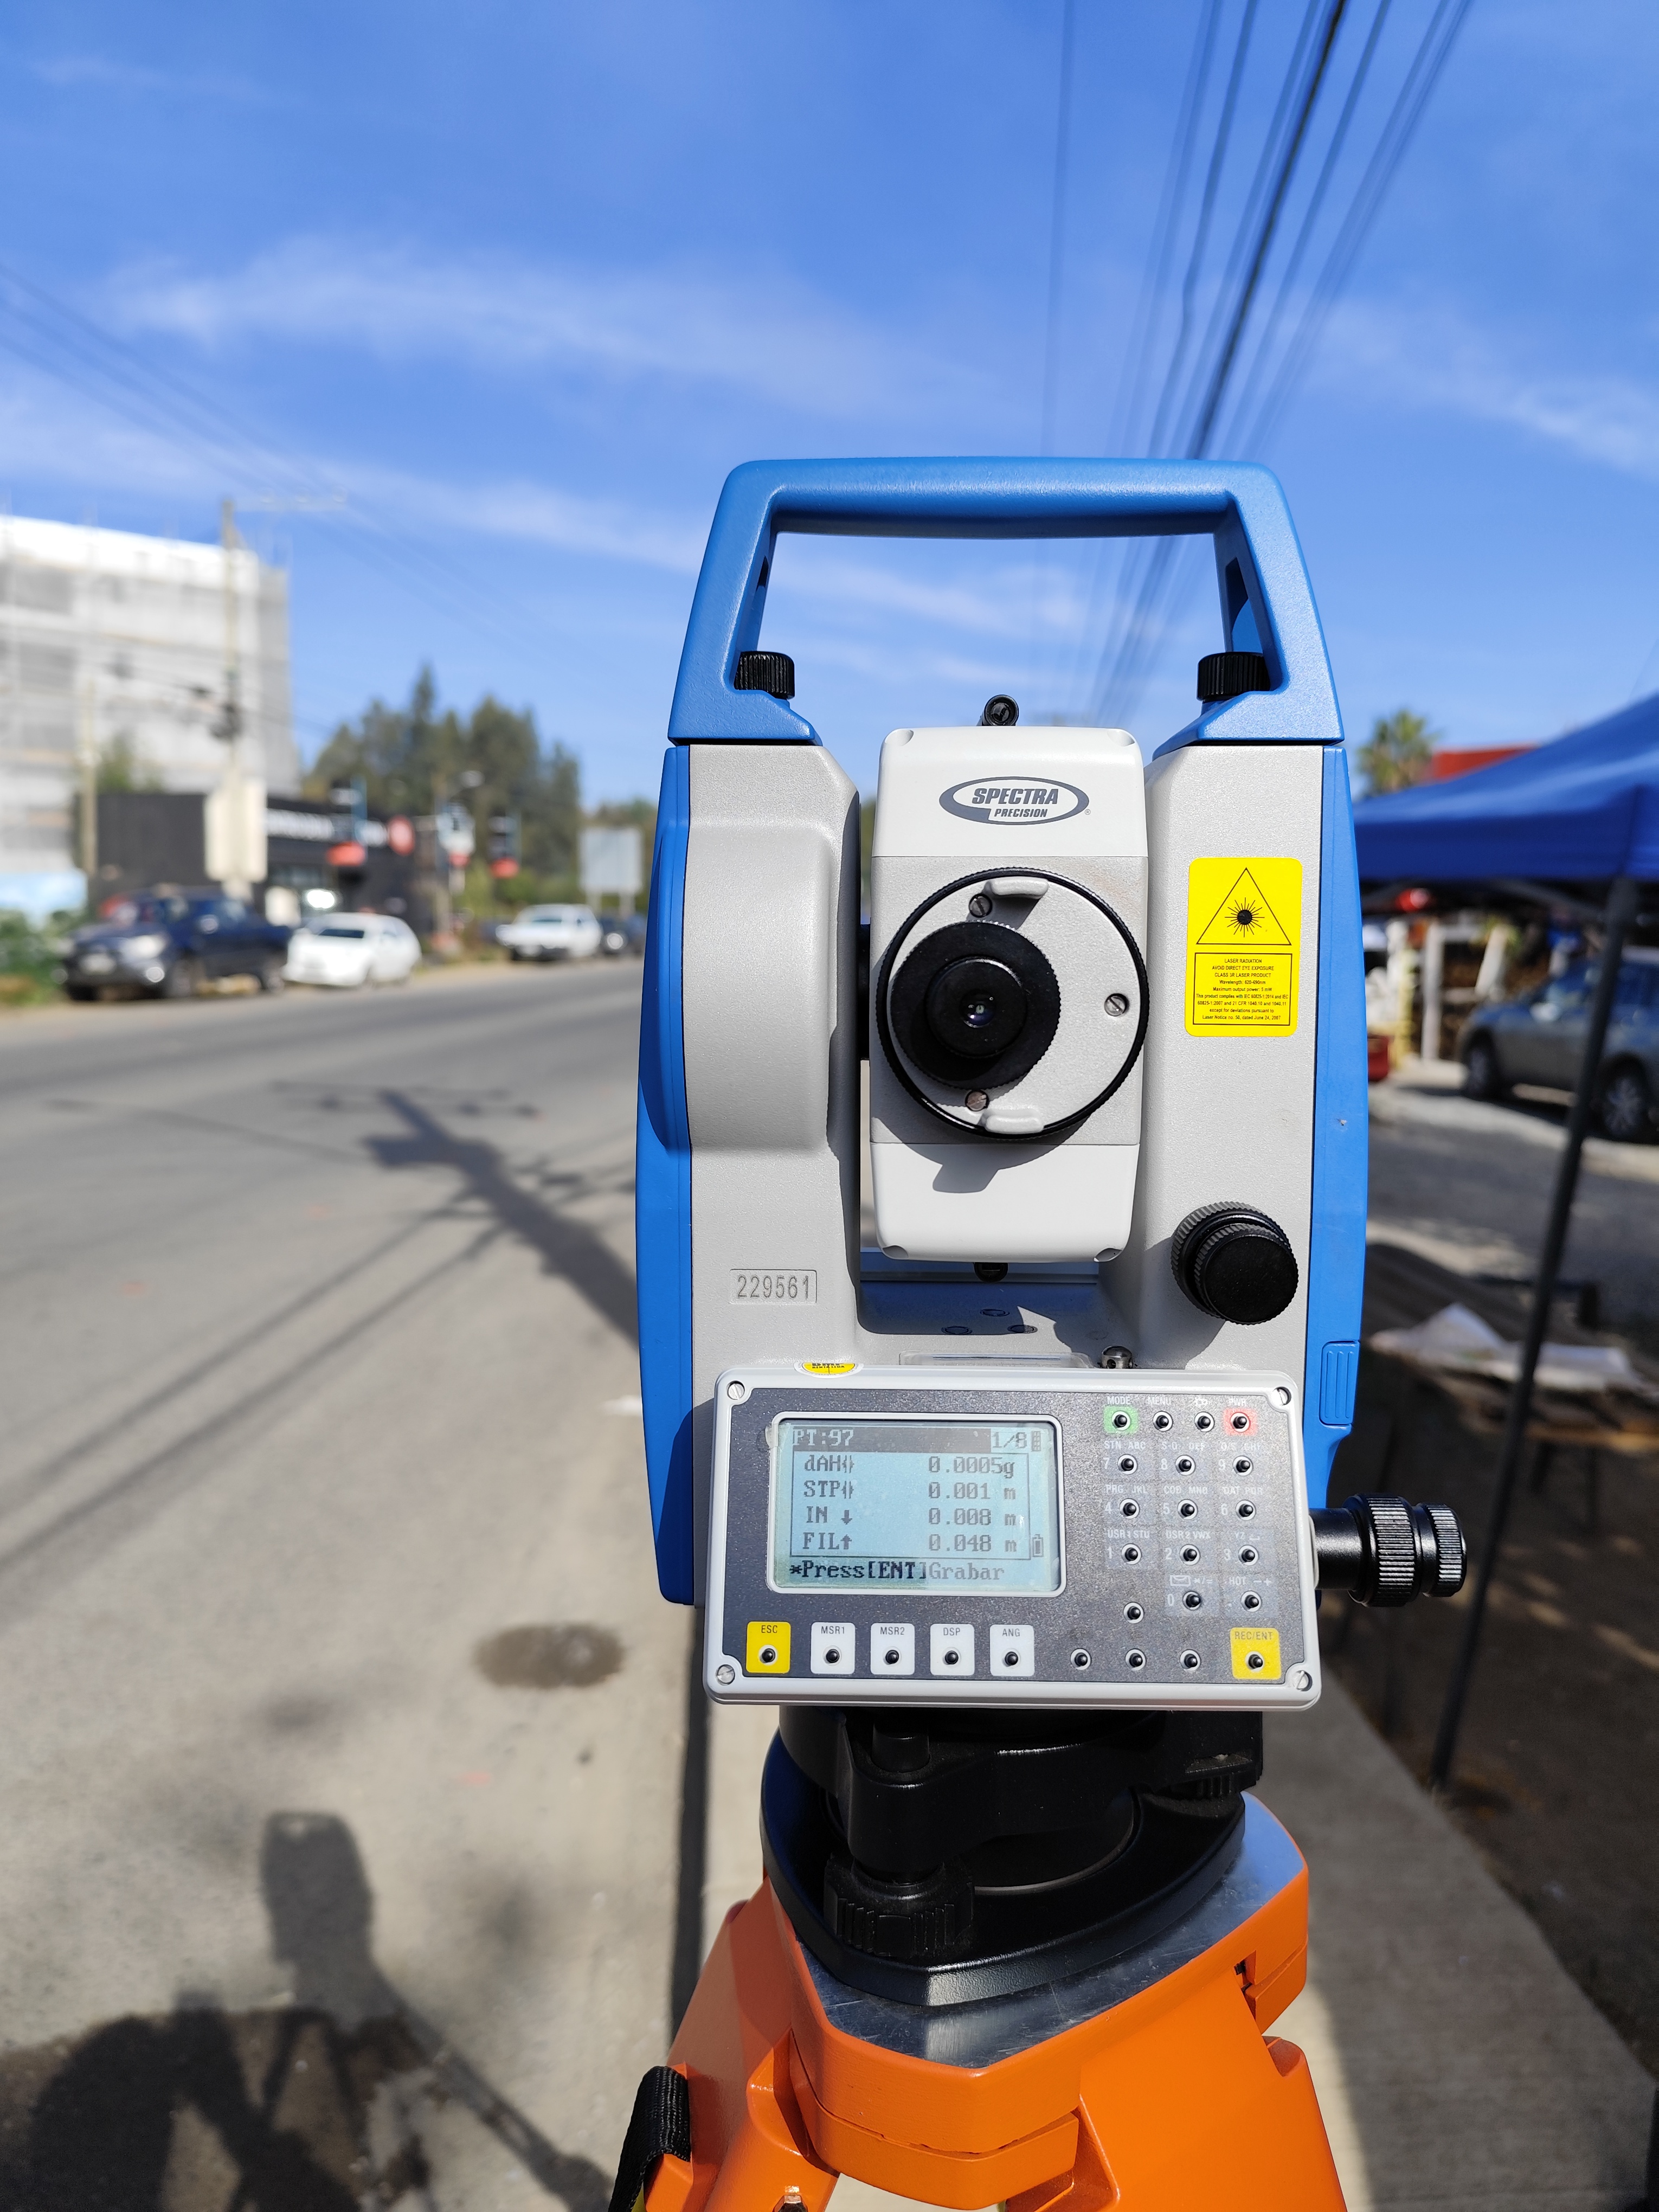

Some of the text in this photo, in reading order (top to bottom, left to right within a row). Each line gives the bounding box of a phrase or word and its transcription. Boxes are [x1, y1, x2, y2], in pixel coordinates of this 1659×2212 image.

[972, 788, 1059, 805] SPECTRA
[994, 808, 1048, 818] PRECISION
[737, 1275, 809, 1299] 229561
[1107, 1396, 1130, 1405] MODE
[1147, 1397, 1171, 1405] MENU
[1229, 1398, 1247, 1406] PWR
[793, 1429, 1027, 1449] PT:97 1/8
[1103, 1441, 1146, 1449] STN ABC
[929, 1456, 1014, 1478] 0.0005g
[1103, 1457, 1110, 1470] 7
[1161, 1458, 1168, 1470] 8
[1218, 1458, 1226, 1471] 9
[803, 1480, 1016, 1500] STP 0.001 m
[1105, 1484, 1123, 1494] PRG
[1163, 1486, 1208, 1495] COD MNO
[1223, 1486, 1240, 1495] DAT
[1104, 1501, 1112, 1514] 4
[1163, 1503, 1170, 1515] 5
[1220, 1503, 1228, 1515] 6
[806, 1506, 1016, 1526] IN 0.008 m
[1134, 1529, 1150, 1539] STU
[1193, 1531, 1211, 1539] VWX
[803, 1532, 1017, 1552] FIL 0.048 m
[1107, 1547, 1112, 1559] 1
[1165, 1548, 1172, 1560] 2
[1224, 1548, 1231, 1560] 3
[1167, 1593, 1174, 1606] 0
[761, 1624, 778, 1634] ESC
[821, 1626, 846, 1635] MSR1
[880, 1626, 905, 1636] MSR2
[943, 1628, 961, 1636] DSP
[1002, 1628, 1020, 1637] ANG
[1234, 1631, 1273, 1641] REC/ENT
